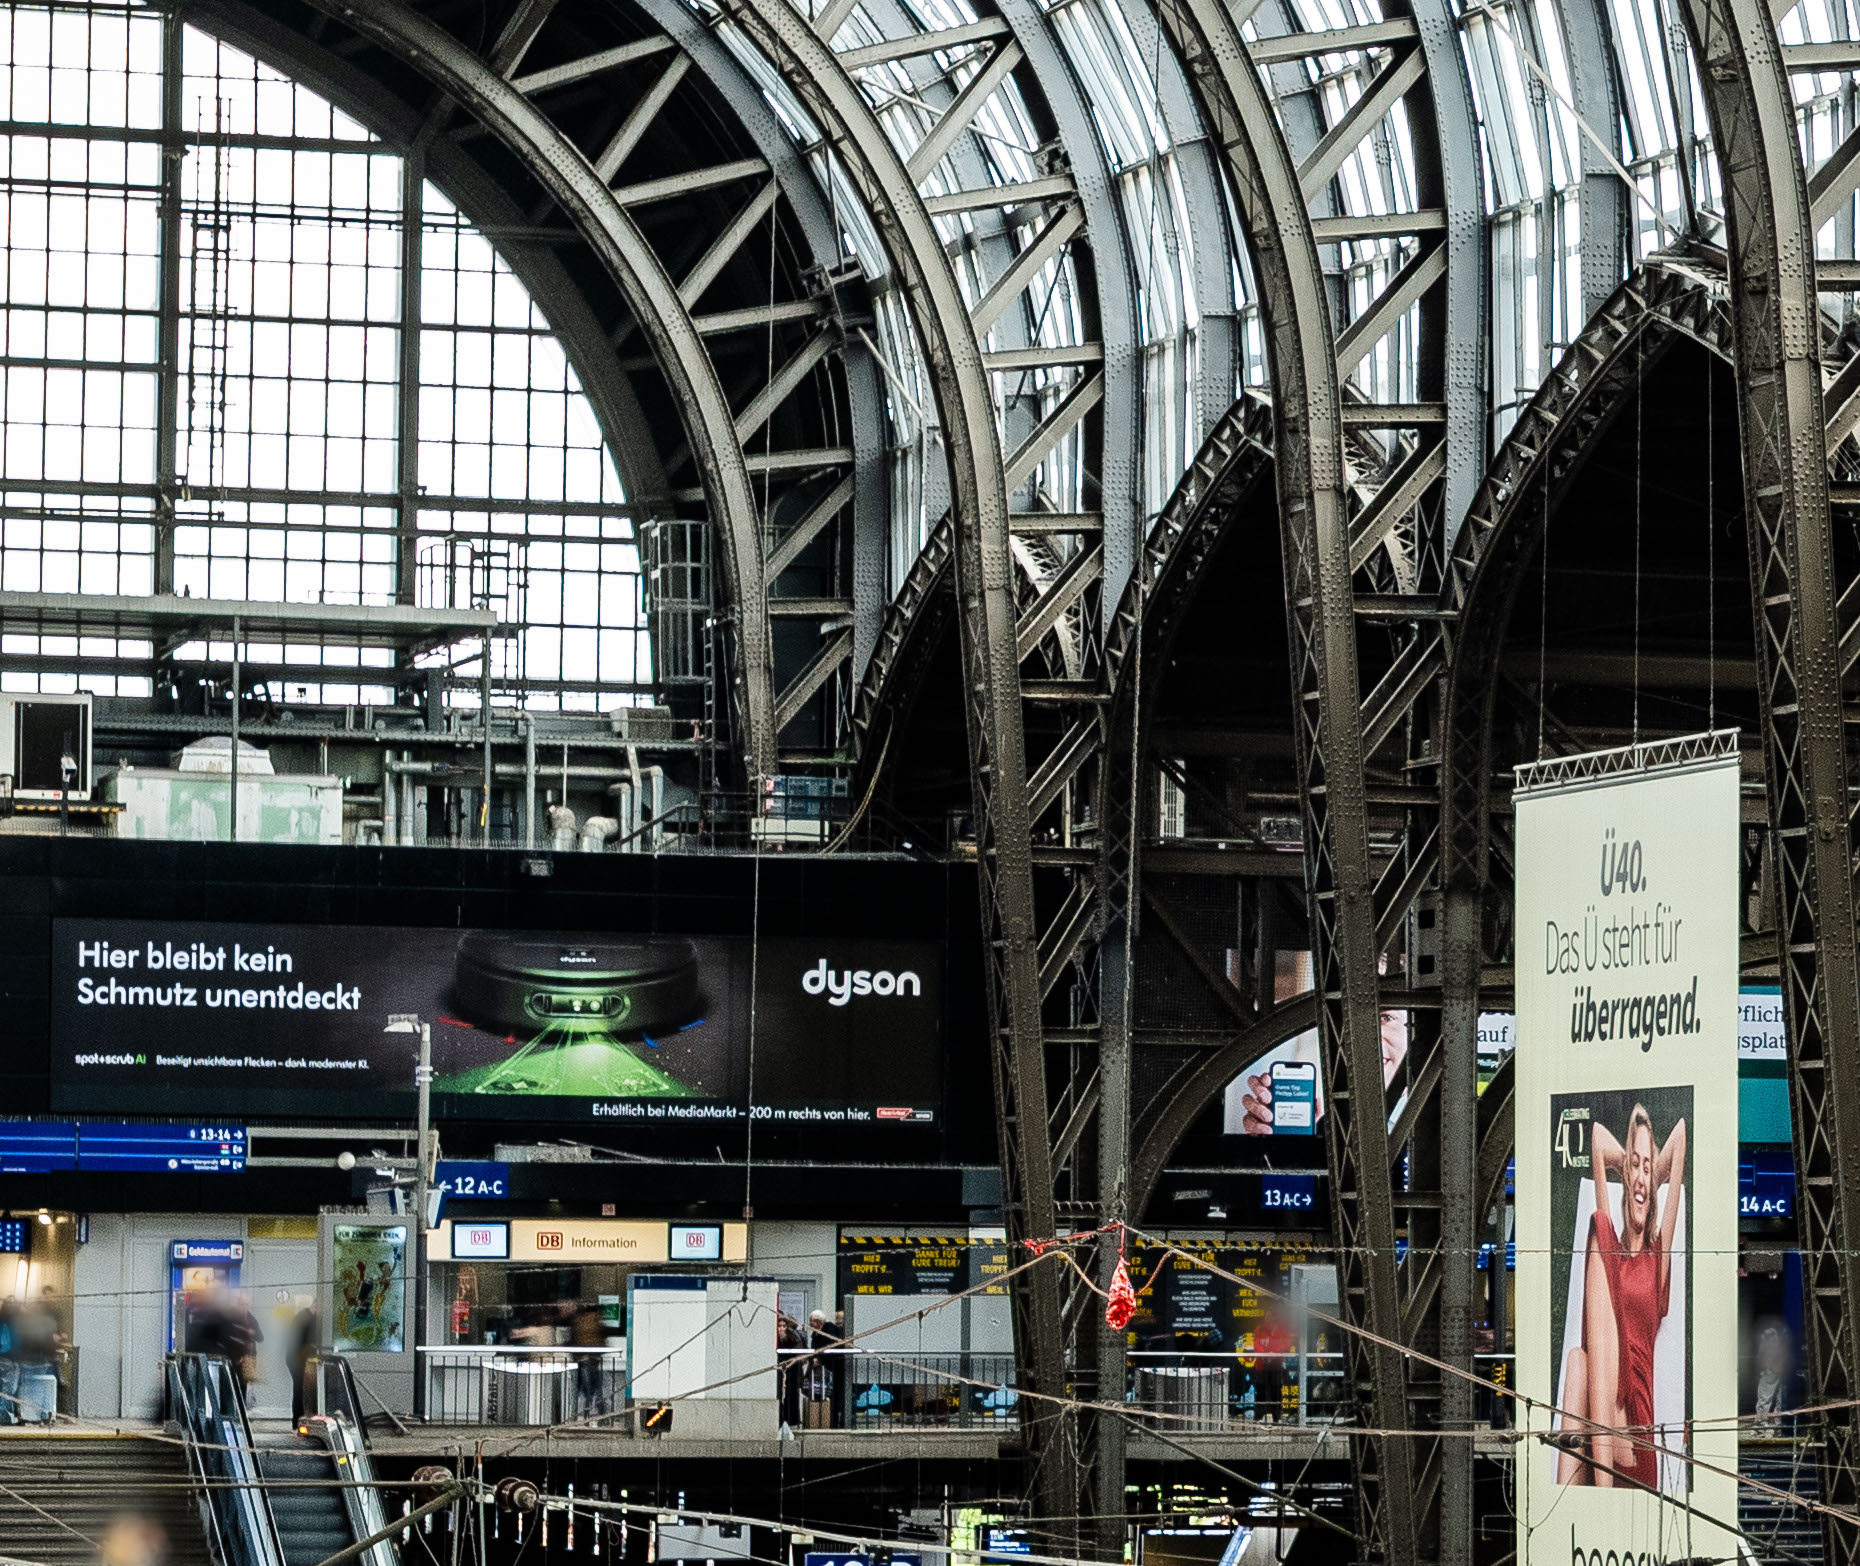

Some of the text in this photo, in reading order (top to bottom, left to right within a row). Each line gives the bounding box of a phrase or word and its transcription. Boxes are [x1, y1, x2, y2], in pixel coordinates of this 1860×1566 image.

[1601, 827, 1647, 897] Ü40.
[1546, 902, 1682, 975] Das Ü steht für
[78, 941, 293, 972] Hier bleibt kein
[802, 958, 921, 1007] dyson
[77, 977, 361, 1010] Schmutz unentdeckt
[1571, 975, 1701, 1053] überragend.
[1477, 1025, 1508, 1043] auf
[75, 1053, 146, 1066] spot+scrub AI
[244, 1056, 276, 1068] Flecken
[285, 1058, 306, 1068] dank
[308, 1058, 356, 1069] modernster
[593, 1103, 645, 1118] Erhältlich
[647, 1104, 666, 1118] bei
[668, 1105, 737, 1119] MediaMarkt
[749, 1106, 772, 1119] 200
[774, 1109, 786, 1119] m
[788, 1107, 821, 1120] rechts
[824, 1110, 845, 1121] von
[847, 1107, 871, 1121] hier.
[455, 1177, 503, 1195] 12 A-C
[1265, 1190, 1301, 1206] 13 A-C
[1741, 1196, 1786, 1213] 14 A-C
[473, 1232, 489, 1245] DB
[539, 1234, 638, 1249] DB Information
[689, 1234, 703, 1246] DB
